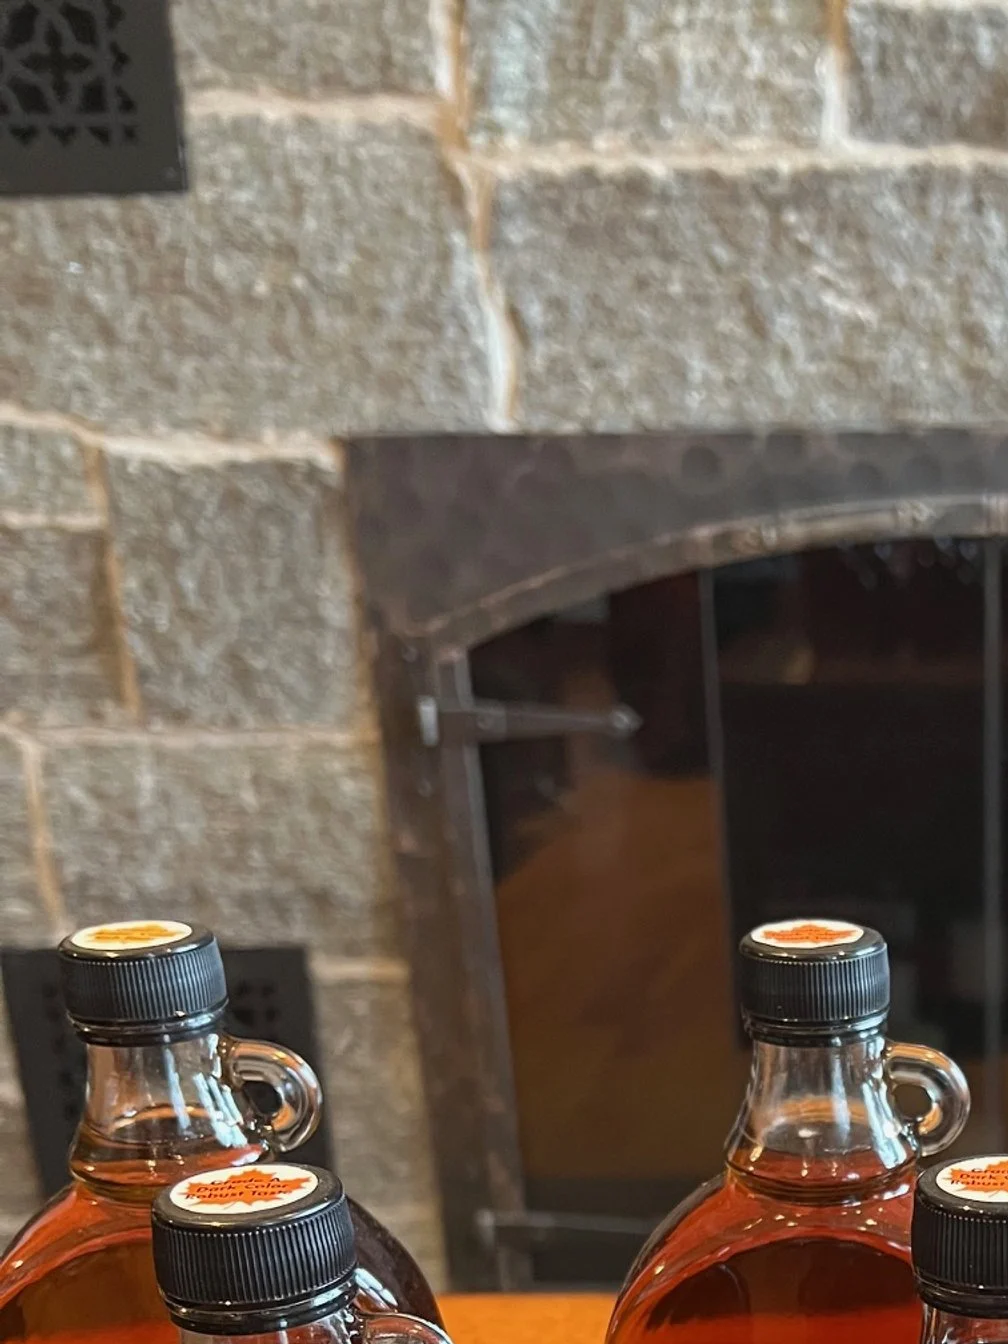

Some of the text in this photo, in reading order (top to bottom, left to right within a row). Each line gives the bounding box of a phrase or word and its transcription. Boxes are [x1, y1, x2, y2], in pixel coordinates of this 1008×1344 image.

[196, 1180, 290, 1192] Dark Color
[185, 1191, 243, 1199] Robust
